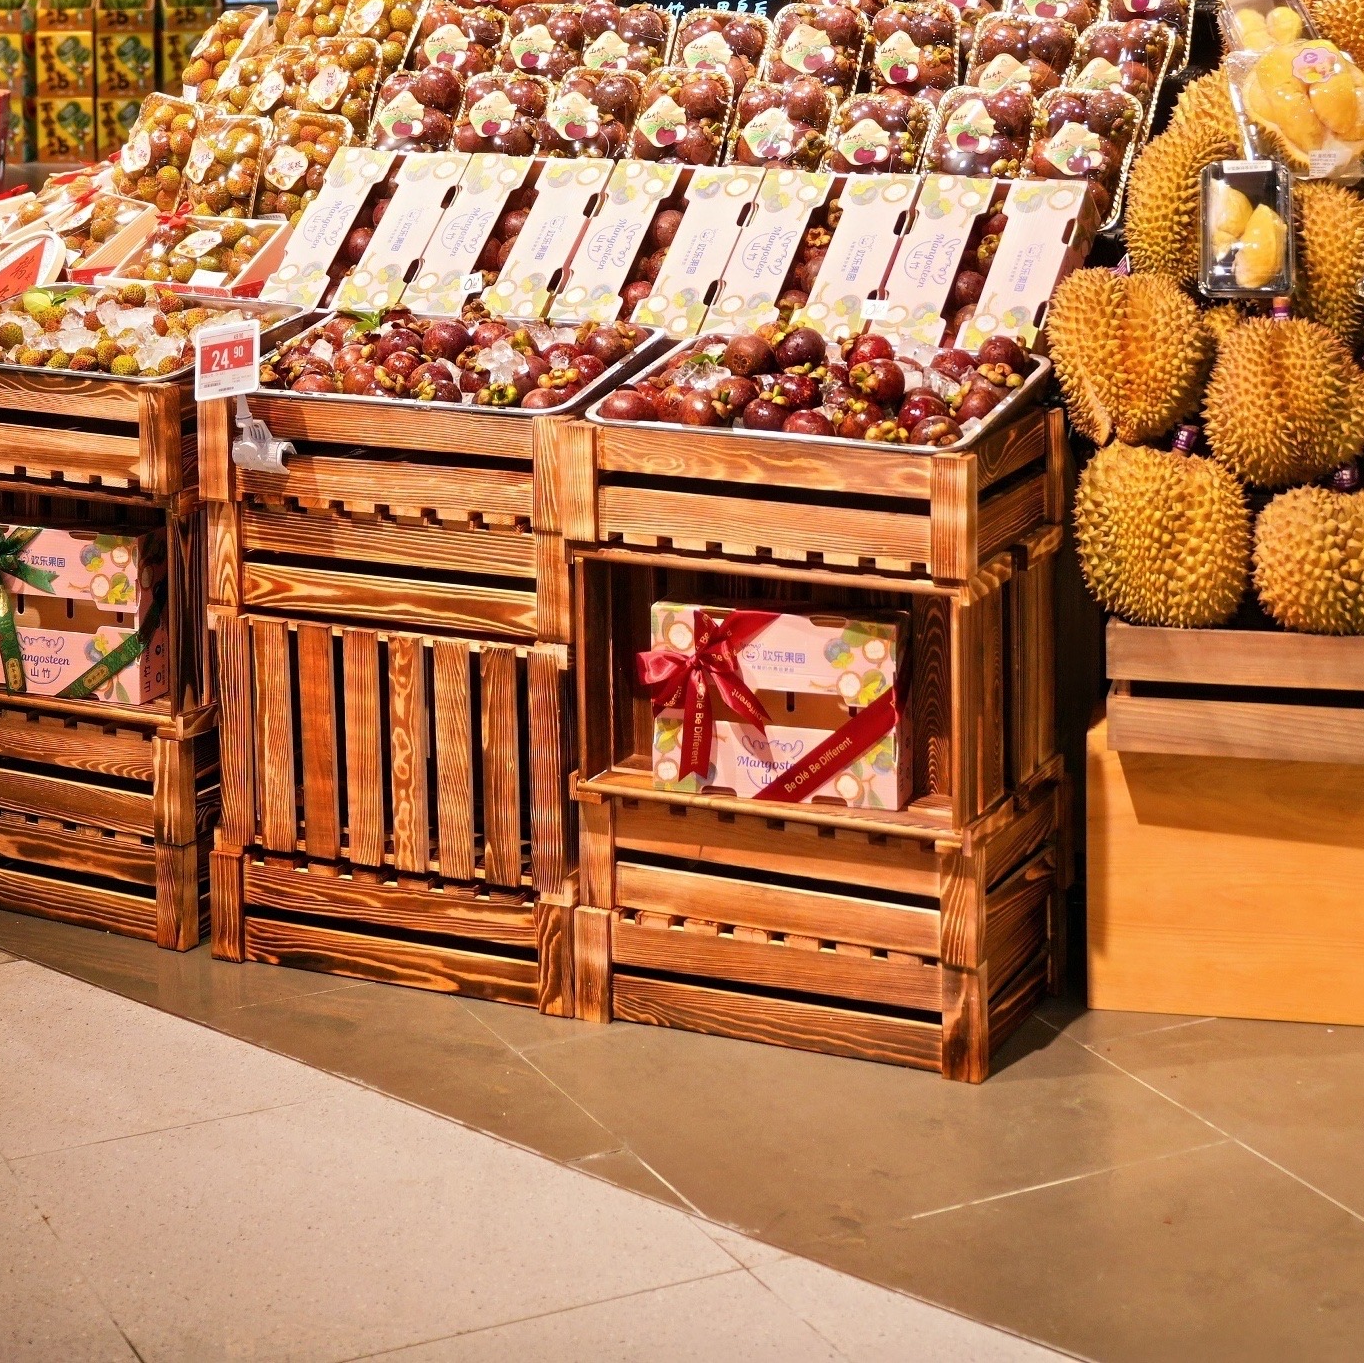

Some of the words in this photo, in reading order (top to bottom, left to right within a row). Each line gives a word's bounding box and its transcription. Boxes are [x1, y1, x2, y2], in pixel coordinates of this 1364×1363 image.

[211, 345, 244, 372] 24.90
[30, 555, 66, 568] 欢乐果园
[20, 651, 70, 668] angosteen
[762, 649, 806, 665] 欢乐果园
[30, 668, 51, 679] 山竹
[695, 712, 704, 725] Be
[691, 726, 703, 765] Different
[737, 755, 796, 773] Mangoste
[784, 778, 797, 793] Be
[809, 759, 822, 774] Be
[820, 736, 853, 767] Different
